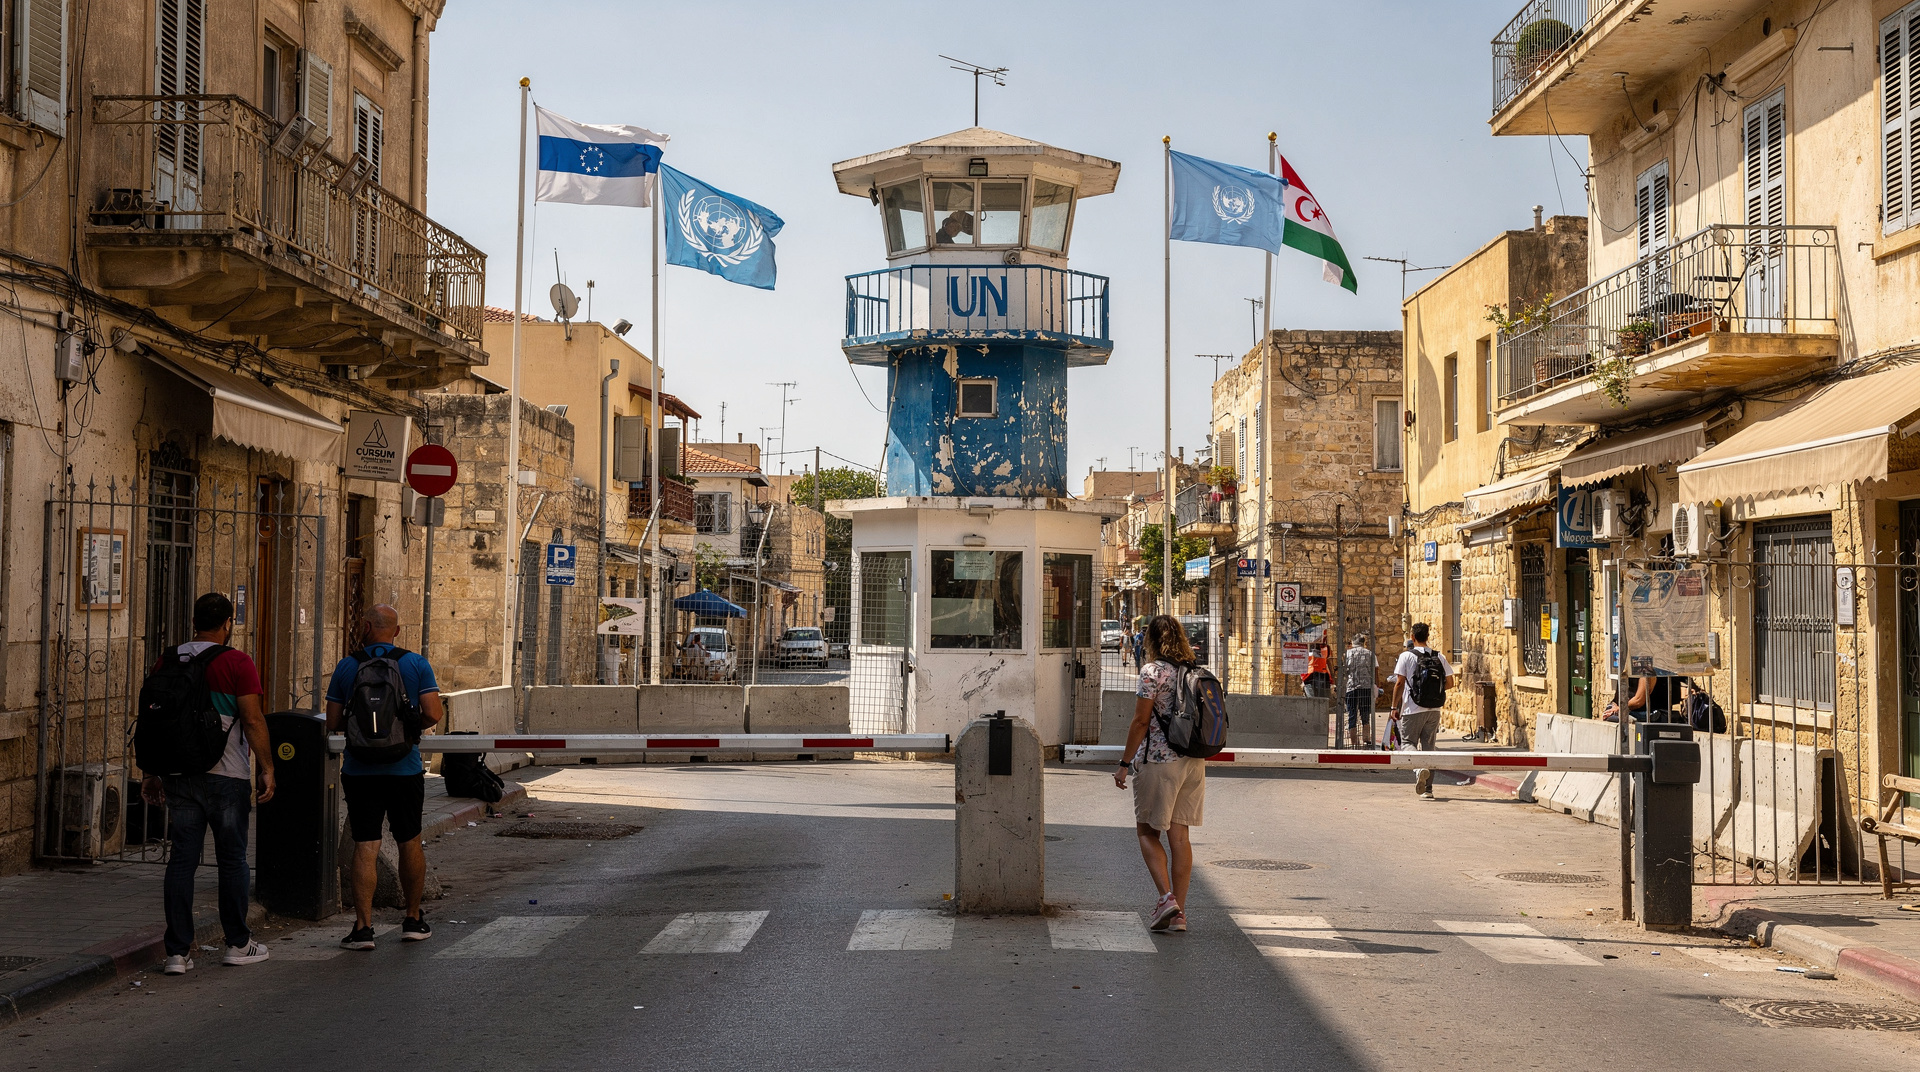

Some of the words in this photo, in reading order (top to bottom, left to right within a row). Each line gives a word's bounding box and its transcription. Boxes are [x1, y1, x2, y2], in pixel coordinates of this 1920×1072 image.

[947, 276, 1007, 317] UN
[356, 448, 395, 458] CURSUM
[553, 547, 569, 563] P
